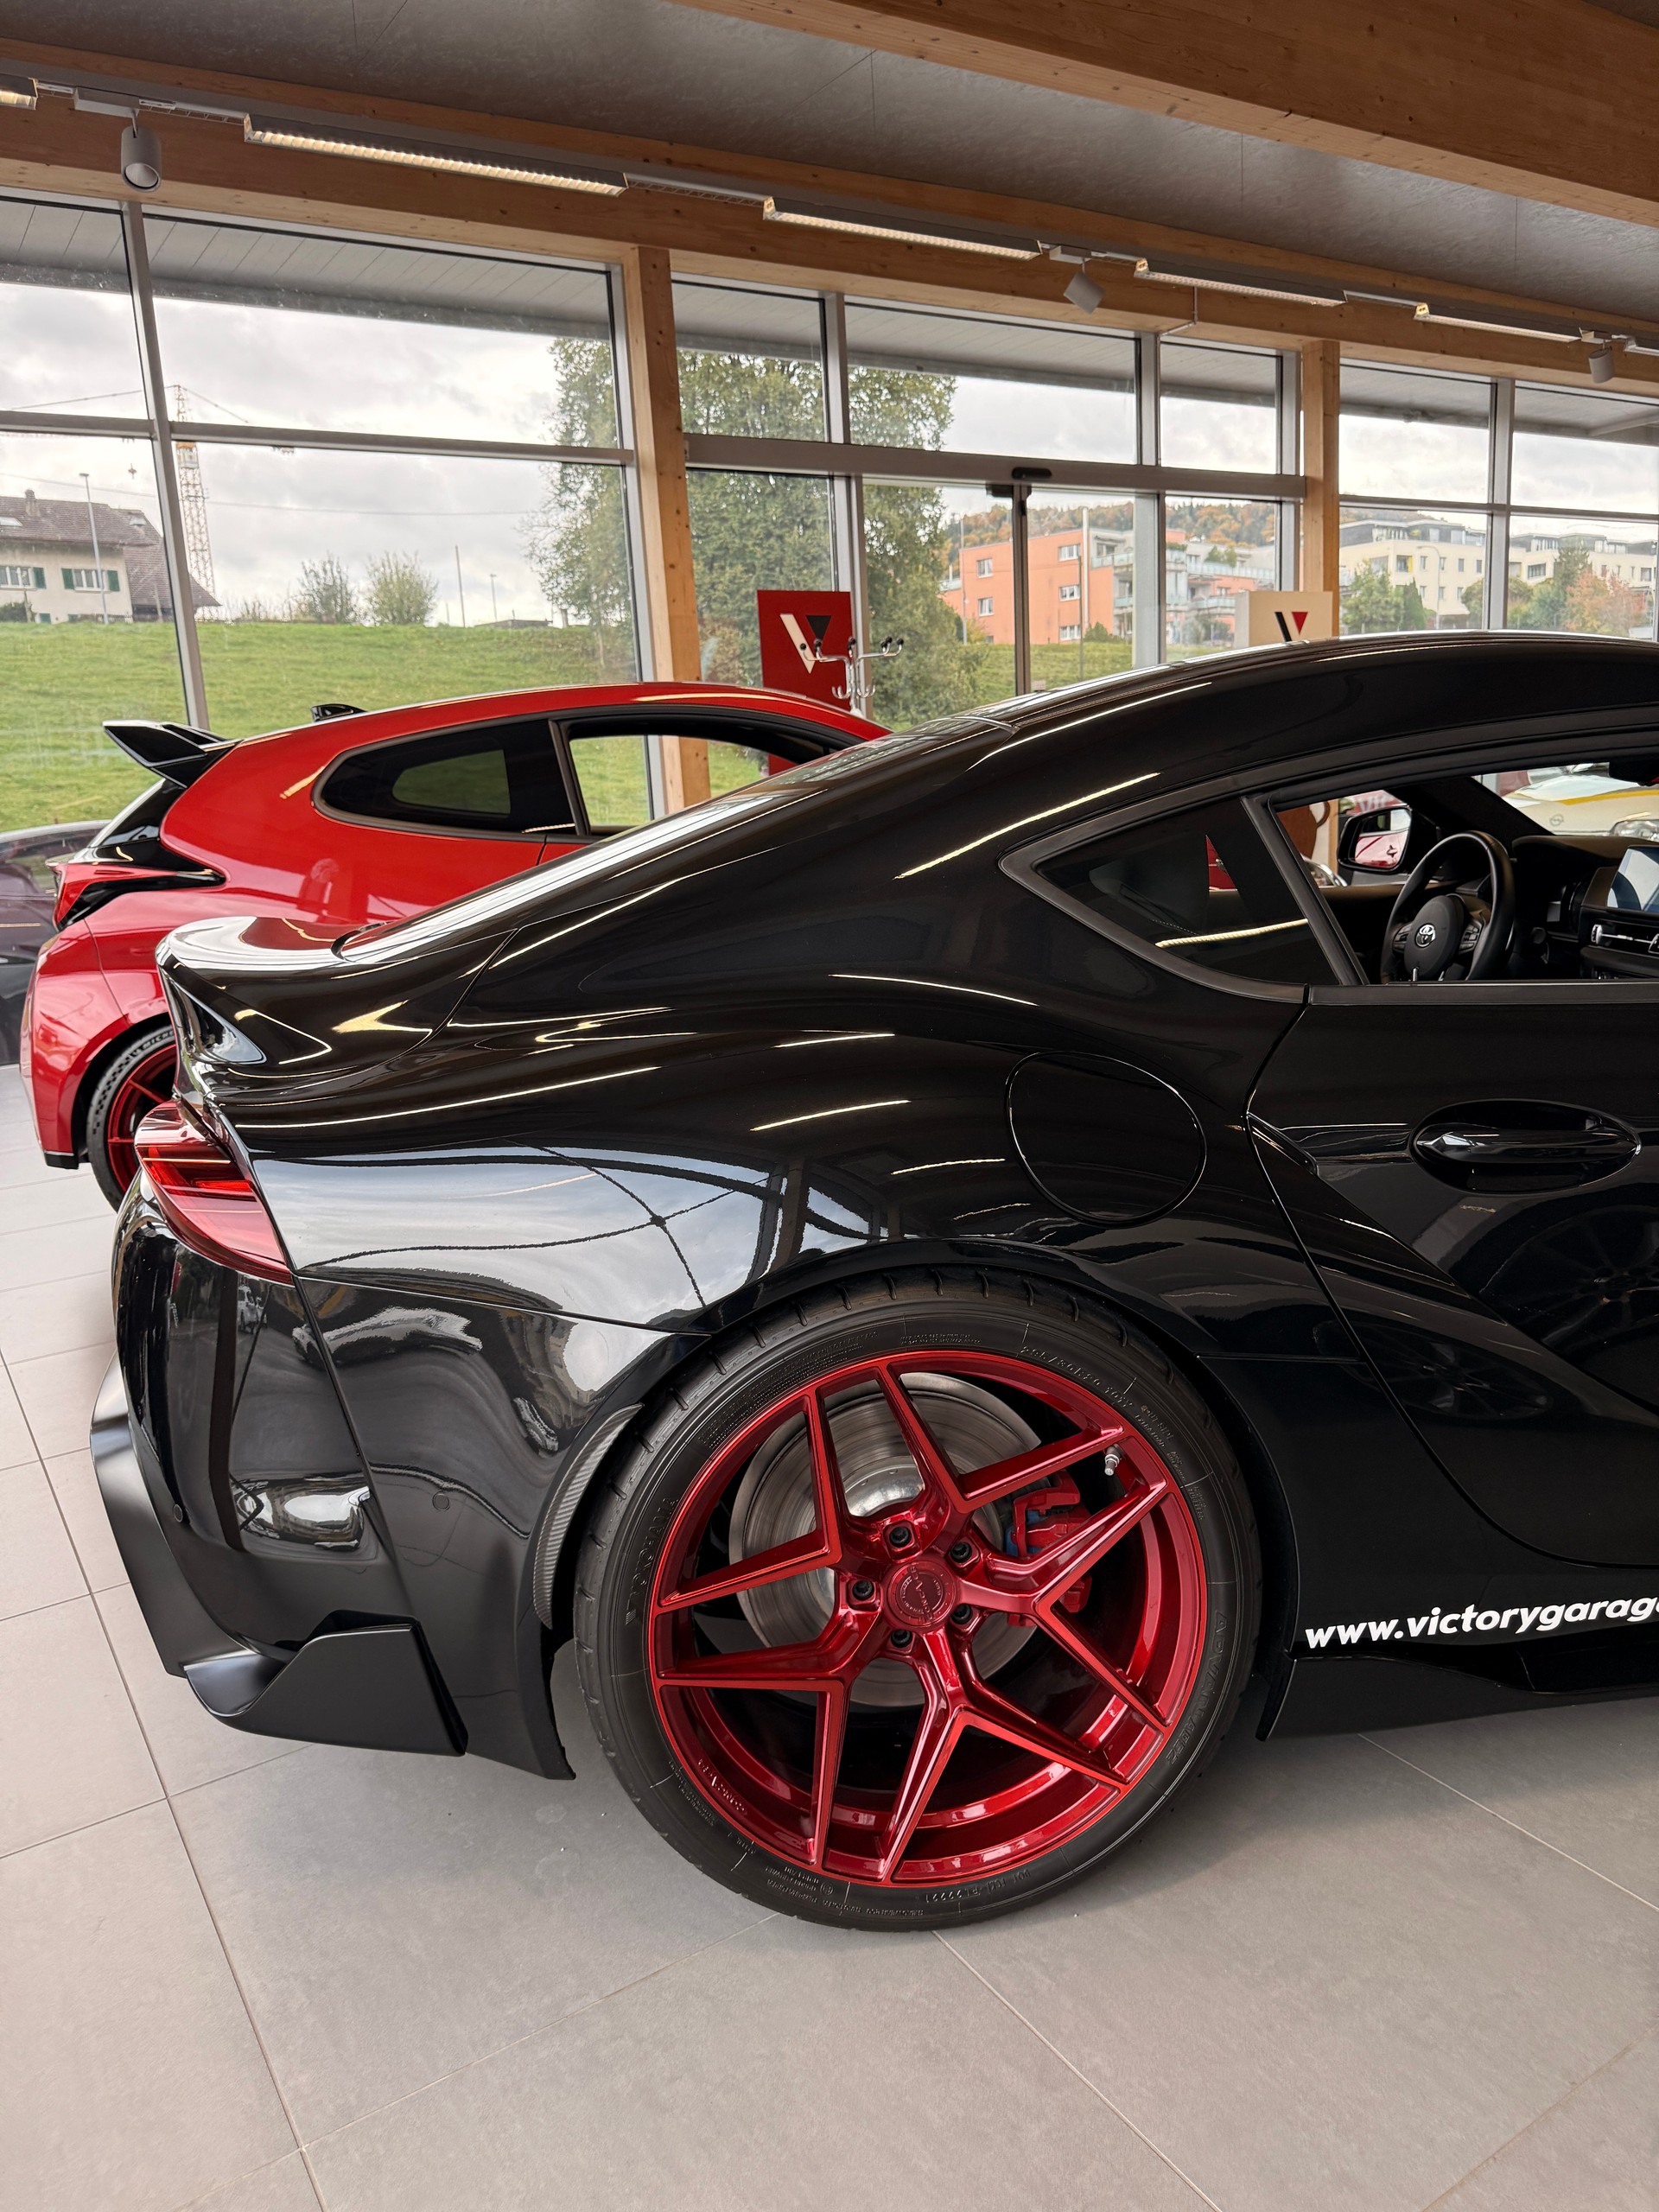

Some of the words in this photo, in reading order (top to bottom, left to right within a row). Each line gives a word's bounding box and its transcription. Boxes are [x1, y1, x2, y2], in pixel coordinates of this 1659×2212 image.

[626, 1497, 680, 1624] YOKOHAMA
[1305, 1596, 1659, 1649] www.victorygarag
[1194, 1610, 1228, 1717] ADVAN
[1166, 1714, 1197, 1765] A052
